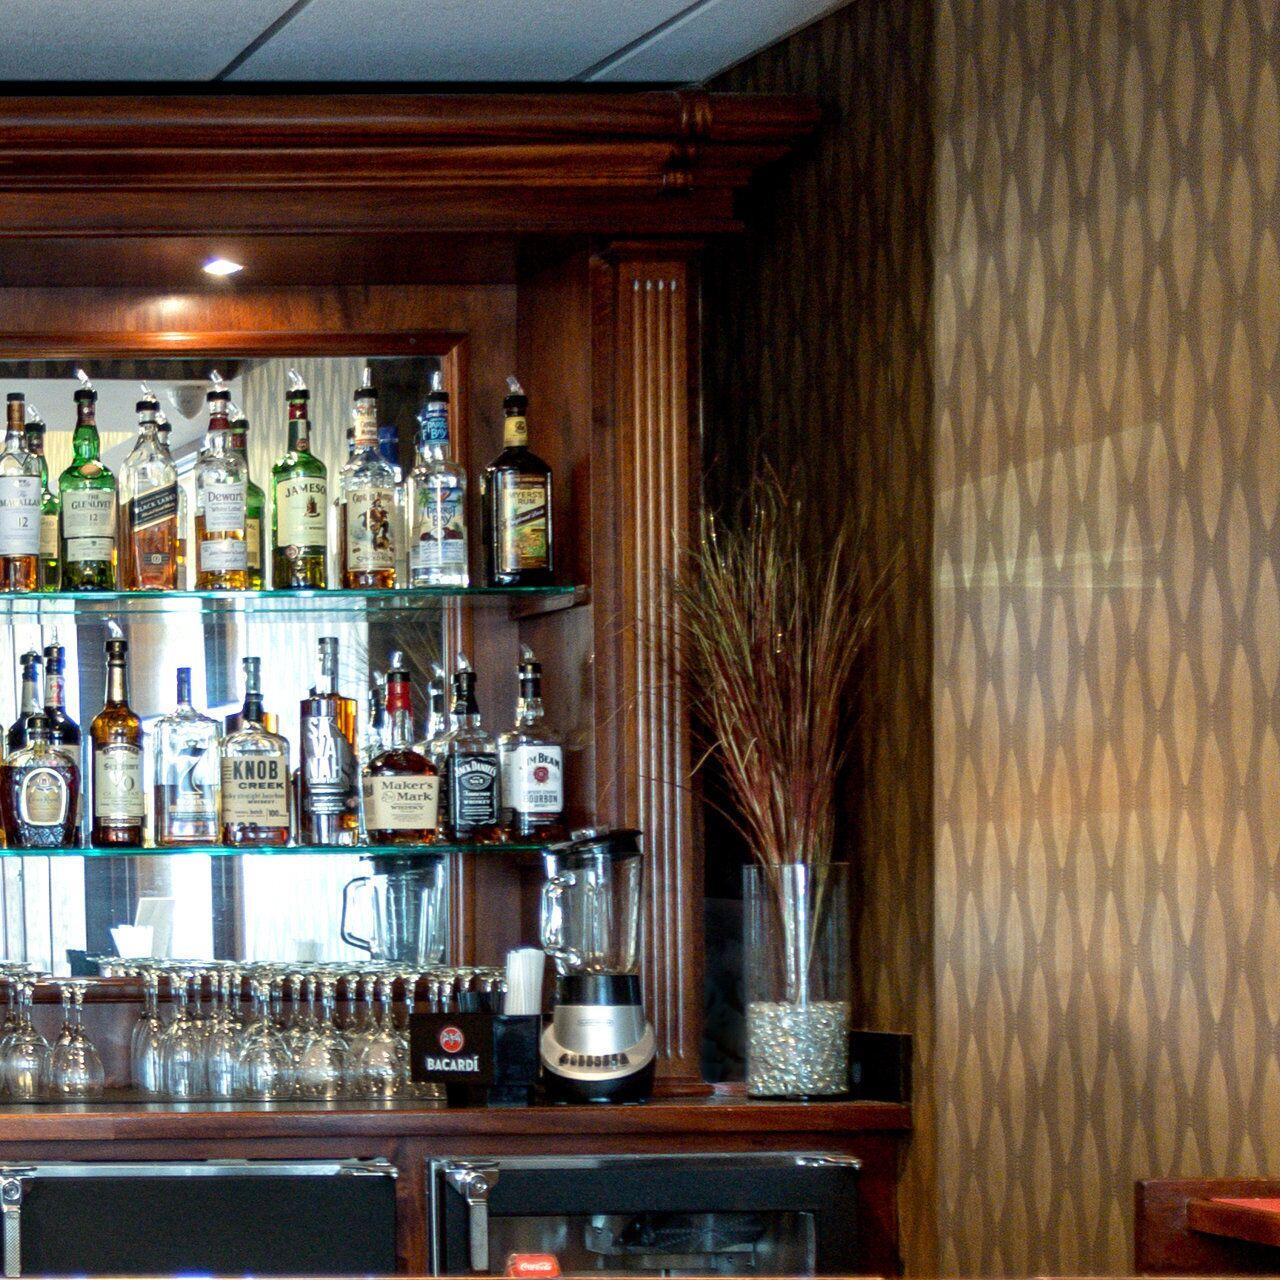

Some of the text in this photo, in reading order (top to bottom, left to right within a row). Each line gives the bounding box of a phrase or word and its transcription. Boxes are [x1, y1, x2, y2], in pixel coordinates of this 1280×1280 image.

[285, 483, 328, 498] JAMESO
[538, 752, 560, 769] BEAM
[233, 760, 278, 781] KNOB
[381, 781, 433, 791] Maker's
[397, 792, 431, 802] Mark
[426, 1056, 480, 1073] BACARDÍ
